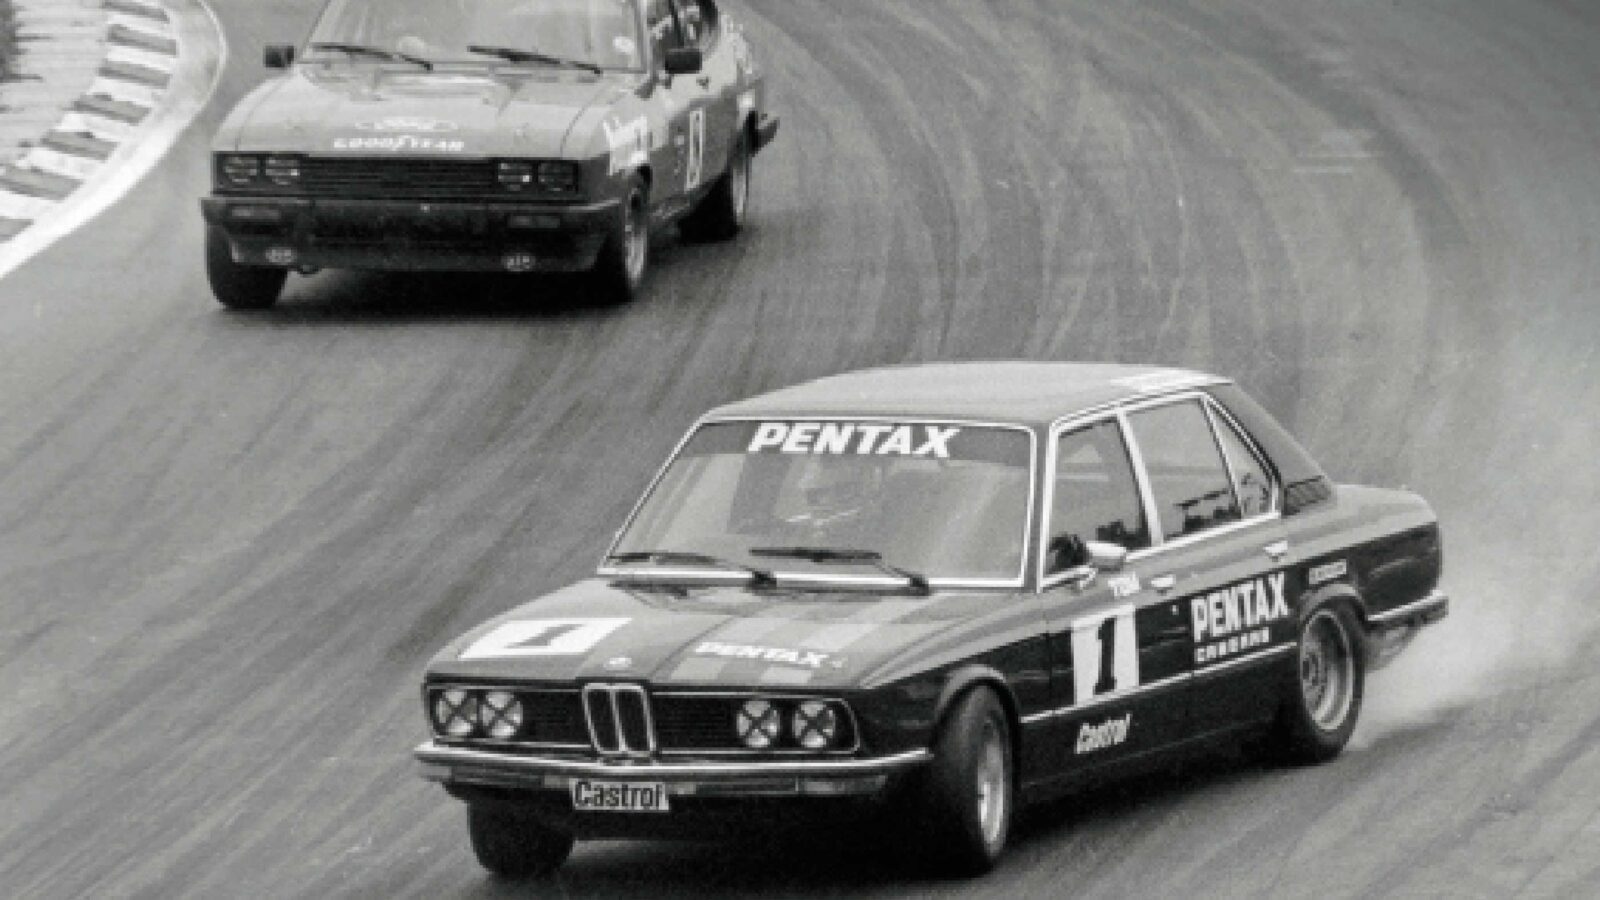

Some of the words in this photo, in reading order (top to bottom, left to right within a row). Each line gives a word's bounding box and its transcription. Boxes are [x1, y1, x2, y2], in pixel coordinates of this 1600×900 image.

[748, 422, 960, 458] PENTAX
[1191, 571, 1288, 642] PENTAX
[503, 623, 587, 649] 1
[695, 641, 829, 668] PENTAX
[1093, 617, 1117, 695] 1
[575, 782, 661, 808] Castrol
